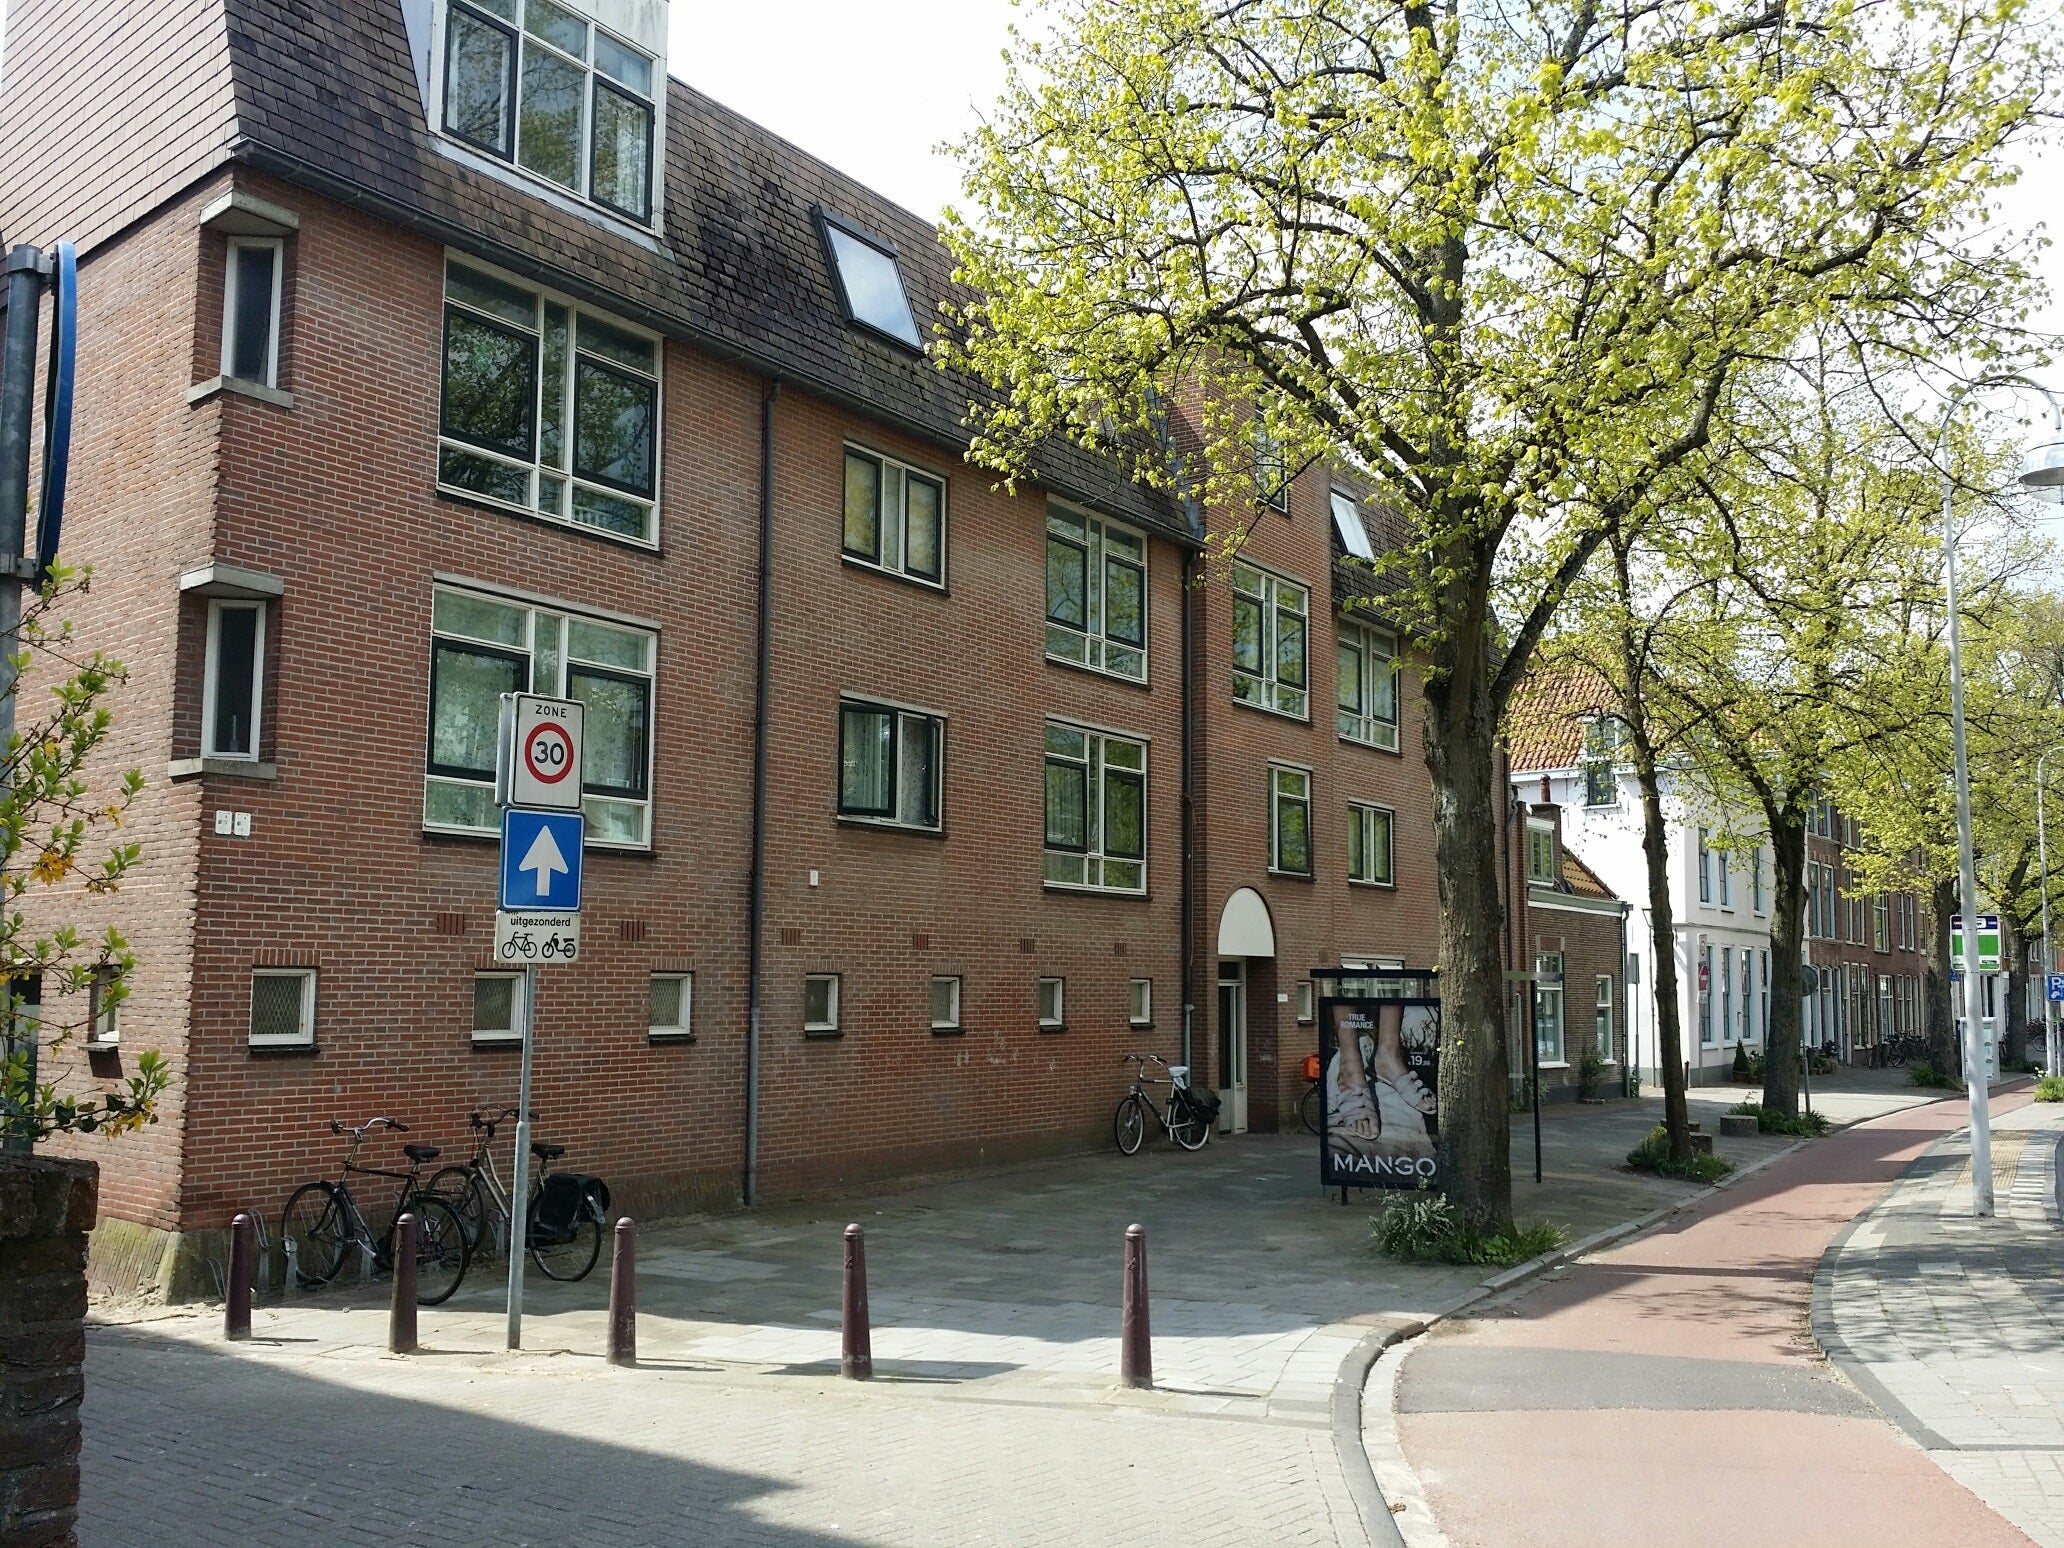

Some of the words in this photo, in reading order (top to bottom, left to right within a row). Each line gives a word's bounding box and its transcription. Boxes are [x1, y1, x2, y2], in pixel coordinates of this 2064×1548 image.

[535, 704, 567, 718] ZONE
[534, 741, 565, 765] 30
[510, 916, 571, 928] uitgezonderd
[1348, 1013, 1366, 1021] TRUE
[1340, 1021, 1374, 1029] ROMANCE
[1334, 1153, 1437, 1176] MANGO
